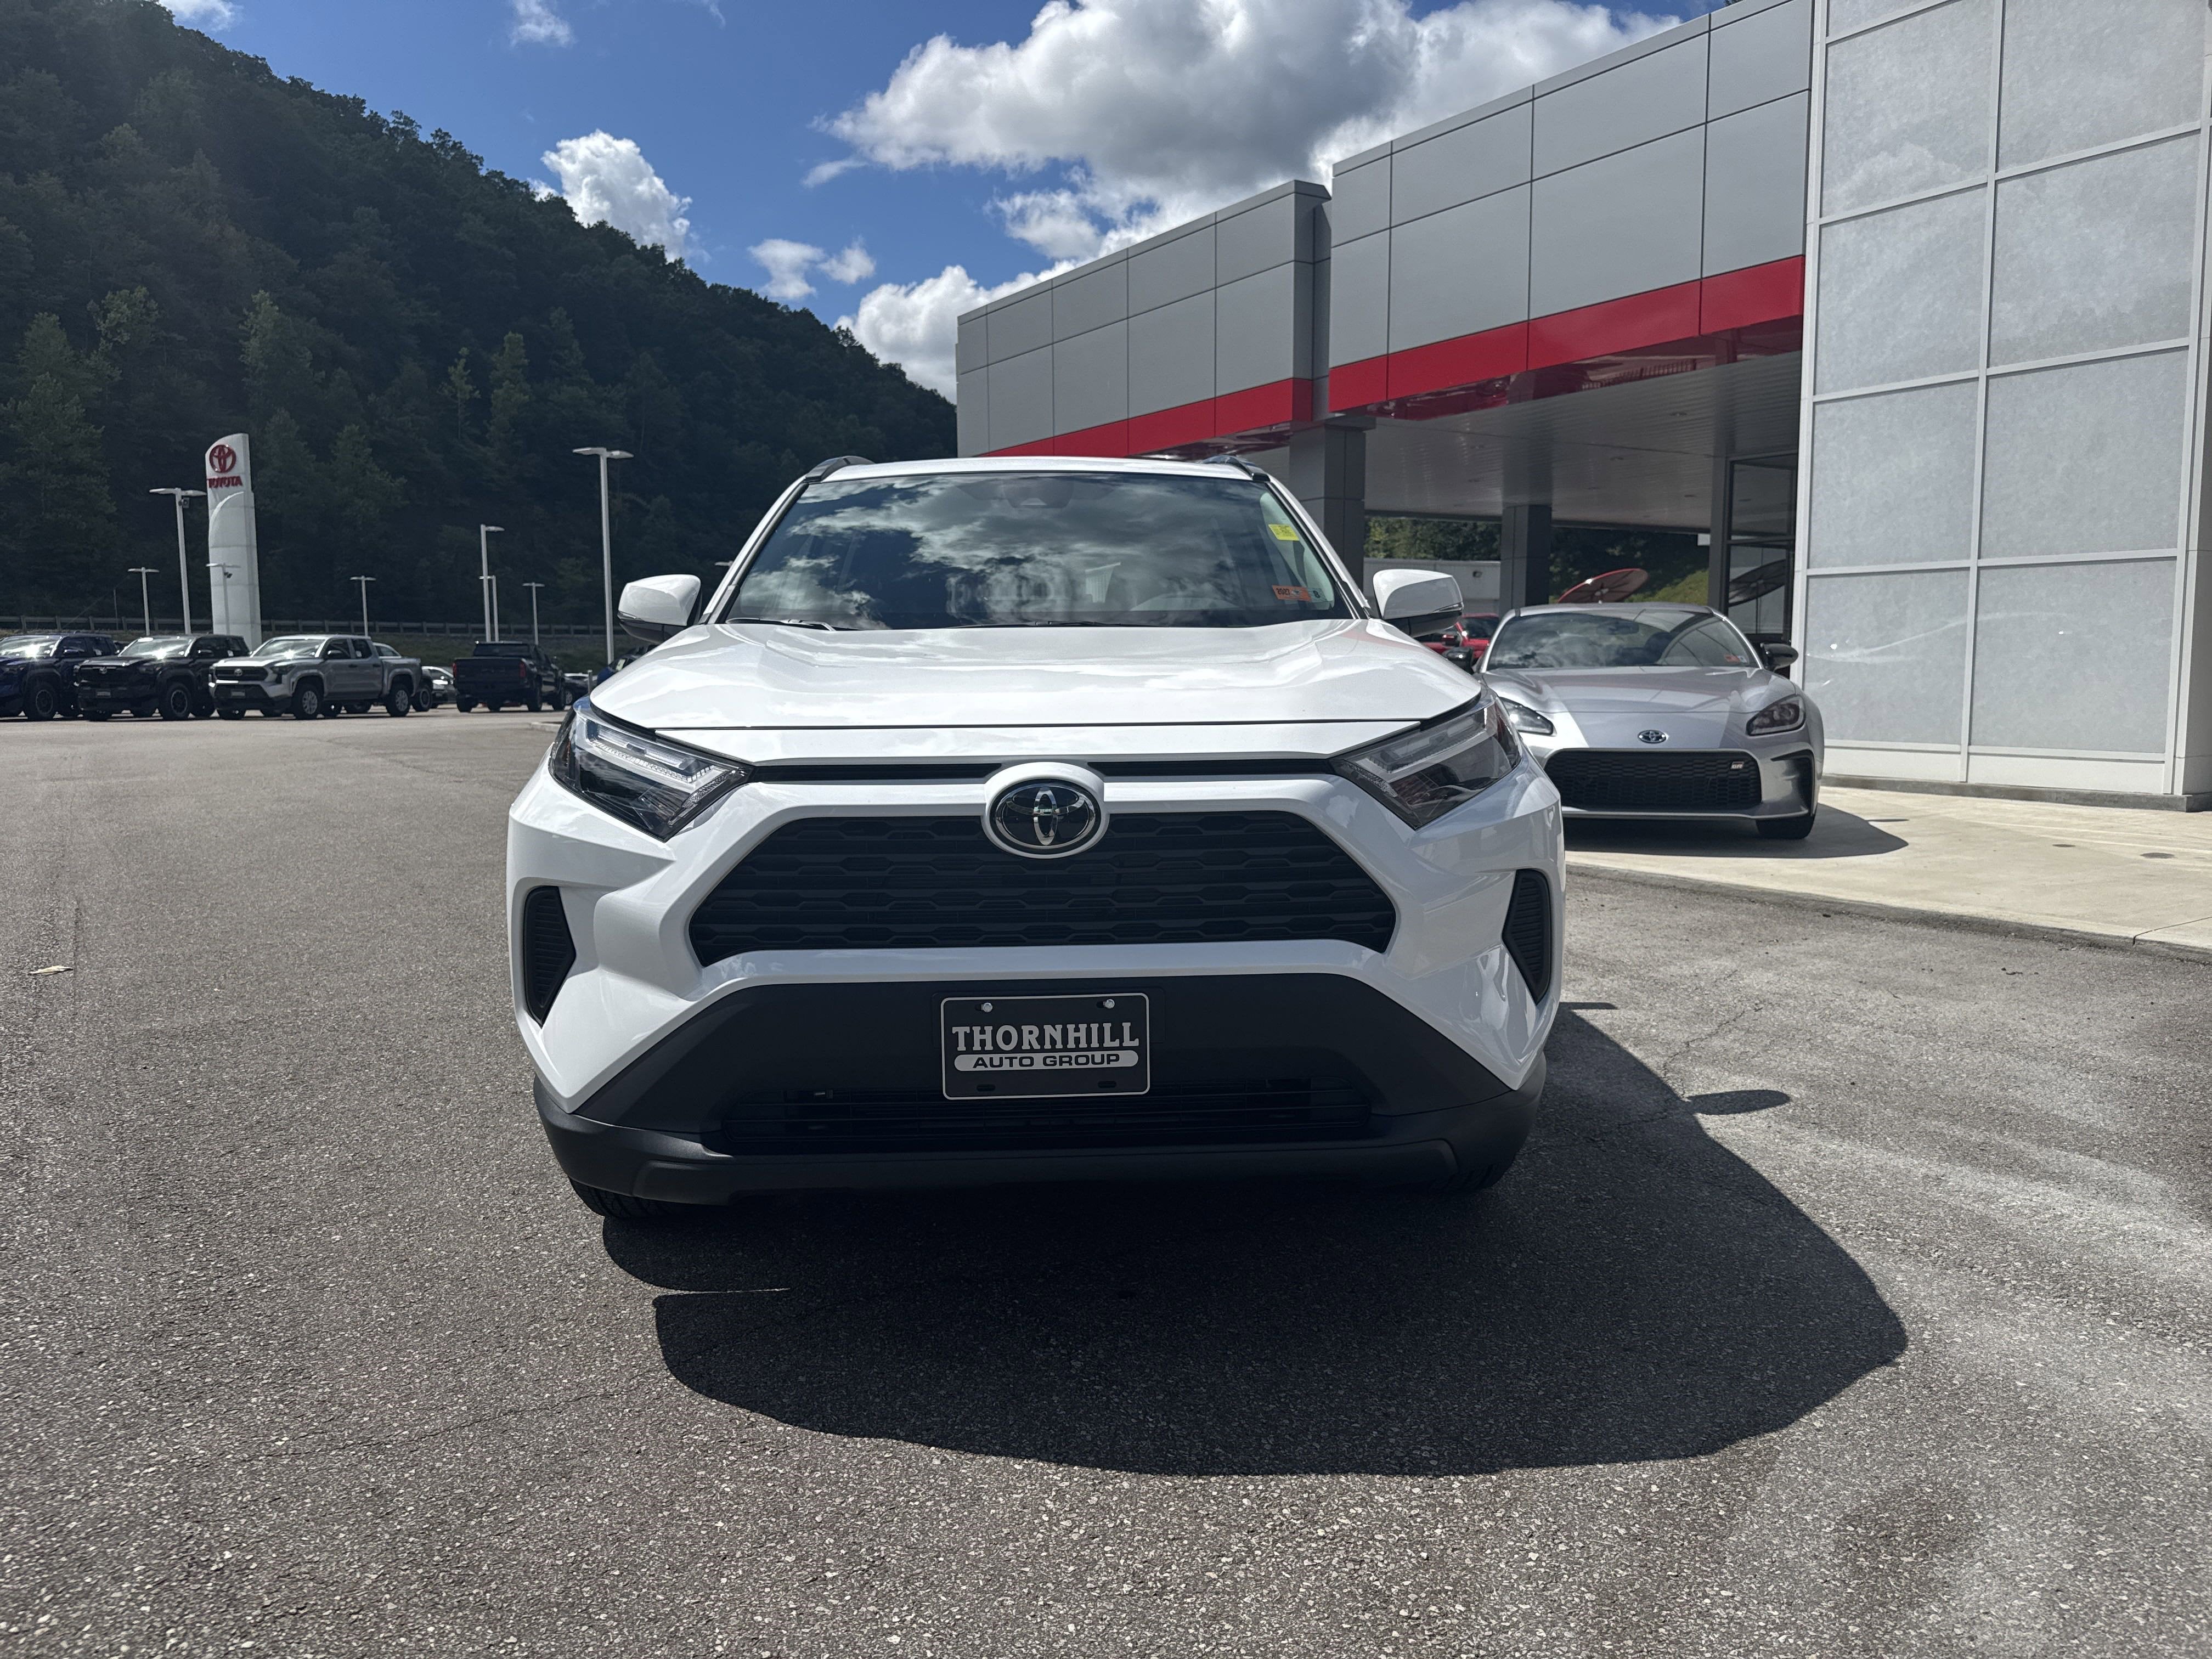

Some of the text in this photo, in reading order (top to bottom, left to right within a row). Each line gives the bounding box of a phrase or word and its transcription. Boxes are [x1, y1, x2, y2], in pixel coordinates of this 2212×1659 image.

[207, 476, 243, 488] TOYOTA
[952, 1022, 1139, 1051] THORNHILL
[973, 1053, 1120, 1068] AUTO GROUP
